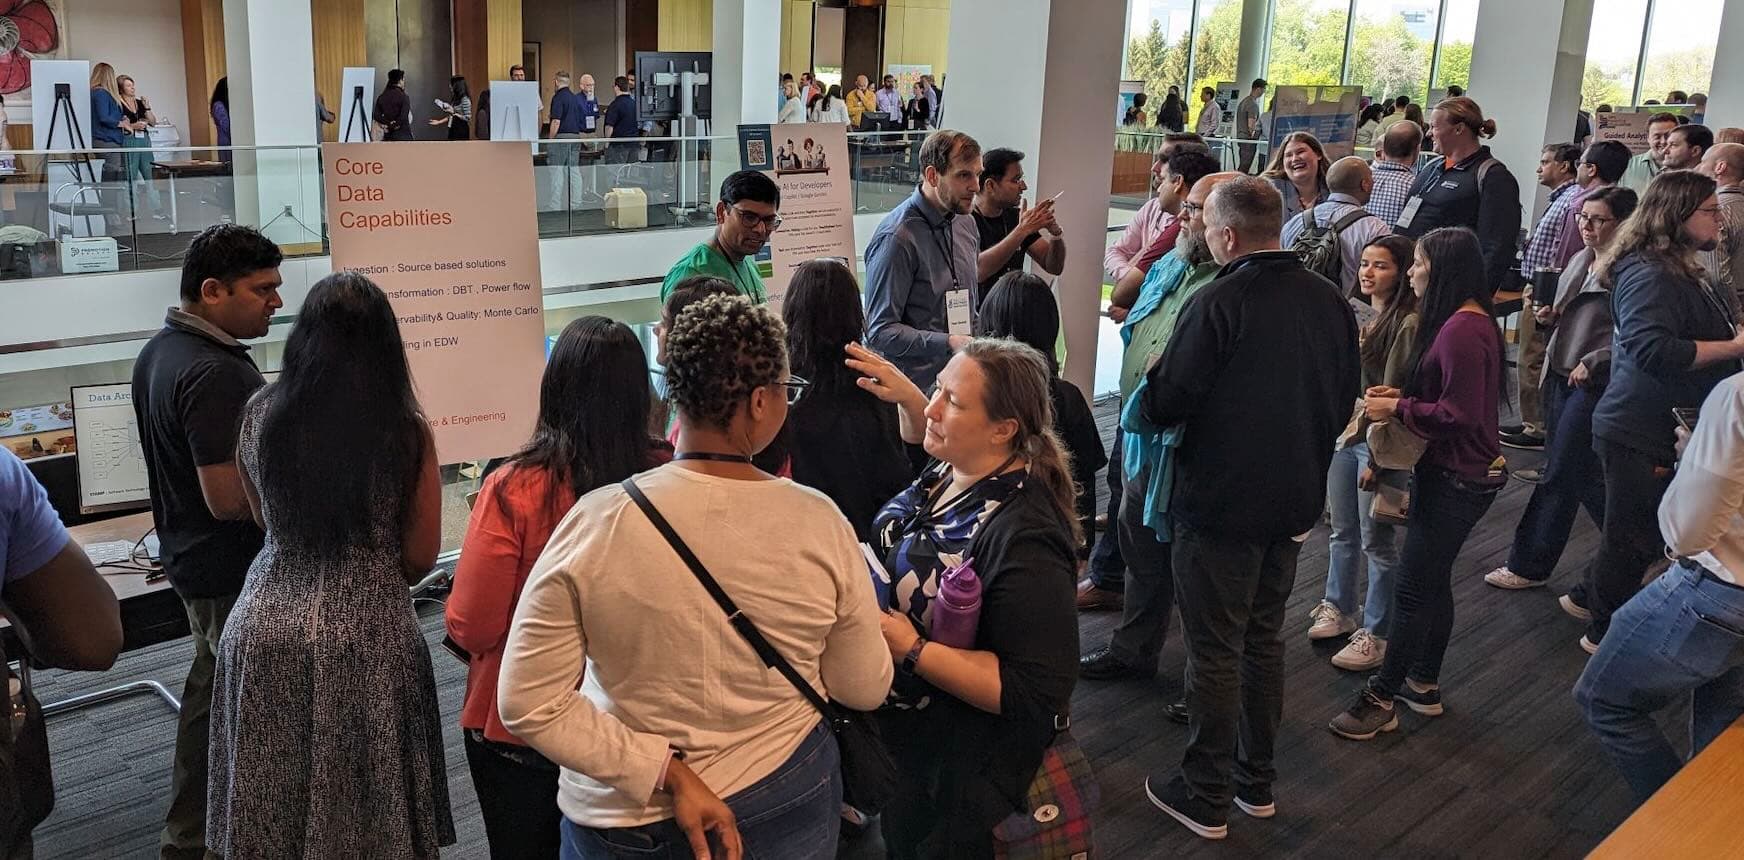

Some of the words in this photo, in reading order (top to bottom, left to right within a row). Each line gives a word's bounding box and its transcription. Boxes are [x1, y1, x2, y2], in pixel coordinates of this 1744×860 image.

[1604, 131, 1626, 139] Guided
[335, 158, 384, 176] Core
[337, 184, 385, 202] Data
[791, 182, 799, 190] for
[800, 180, 833, 190] Developers
[340, 208, 453, 232] Capabilities
[397, 262, 432, 273] Source
[434, 259, 463, 271] based
[465, 257, 507, 269] solutions
[385, 287, 445, 299] nsformation
[452, 284, 474, 295] DBT
[481, 283, 511, 293] Power
[512, 281, 531, 291] flow
[446, 311, 481, 321] Quality:
[484, 307, 513, 318] Monte
[514, 305, 539, 316] Carlo
[422, 338, 432, 348] in
[434, 336, 459, 347] EDW
[88, 392, 112, 402] Data
[441, 416, 448, 426] &
[451, 411, 506, 425] Engineering
